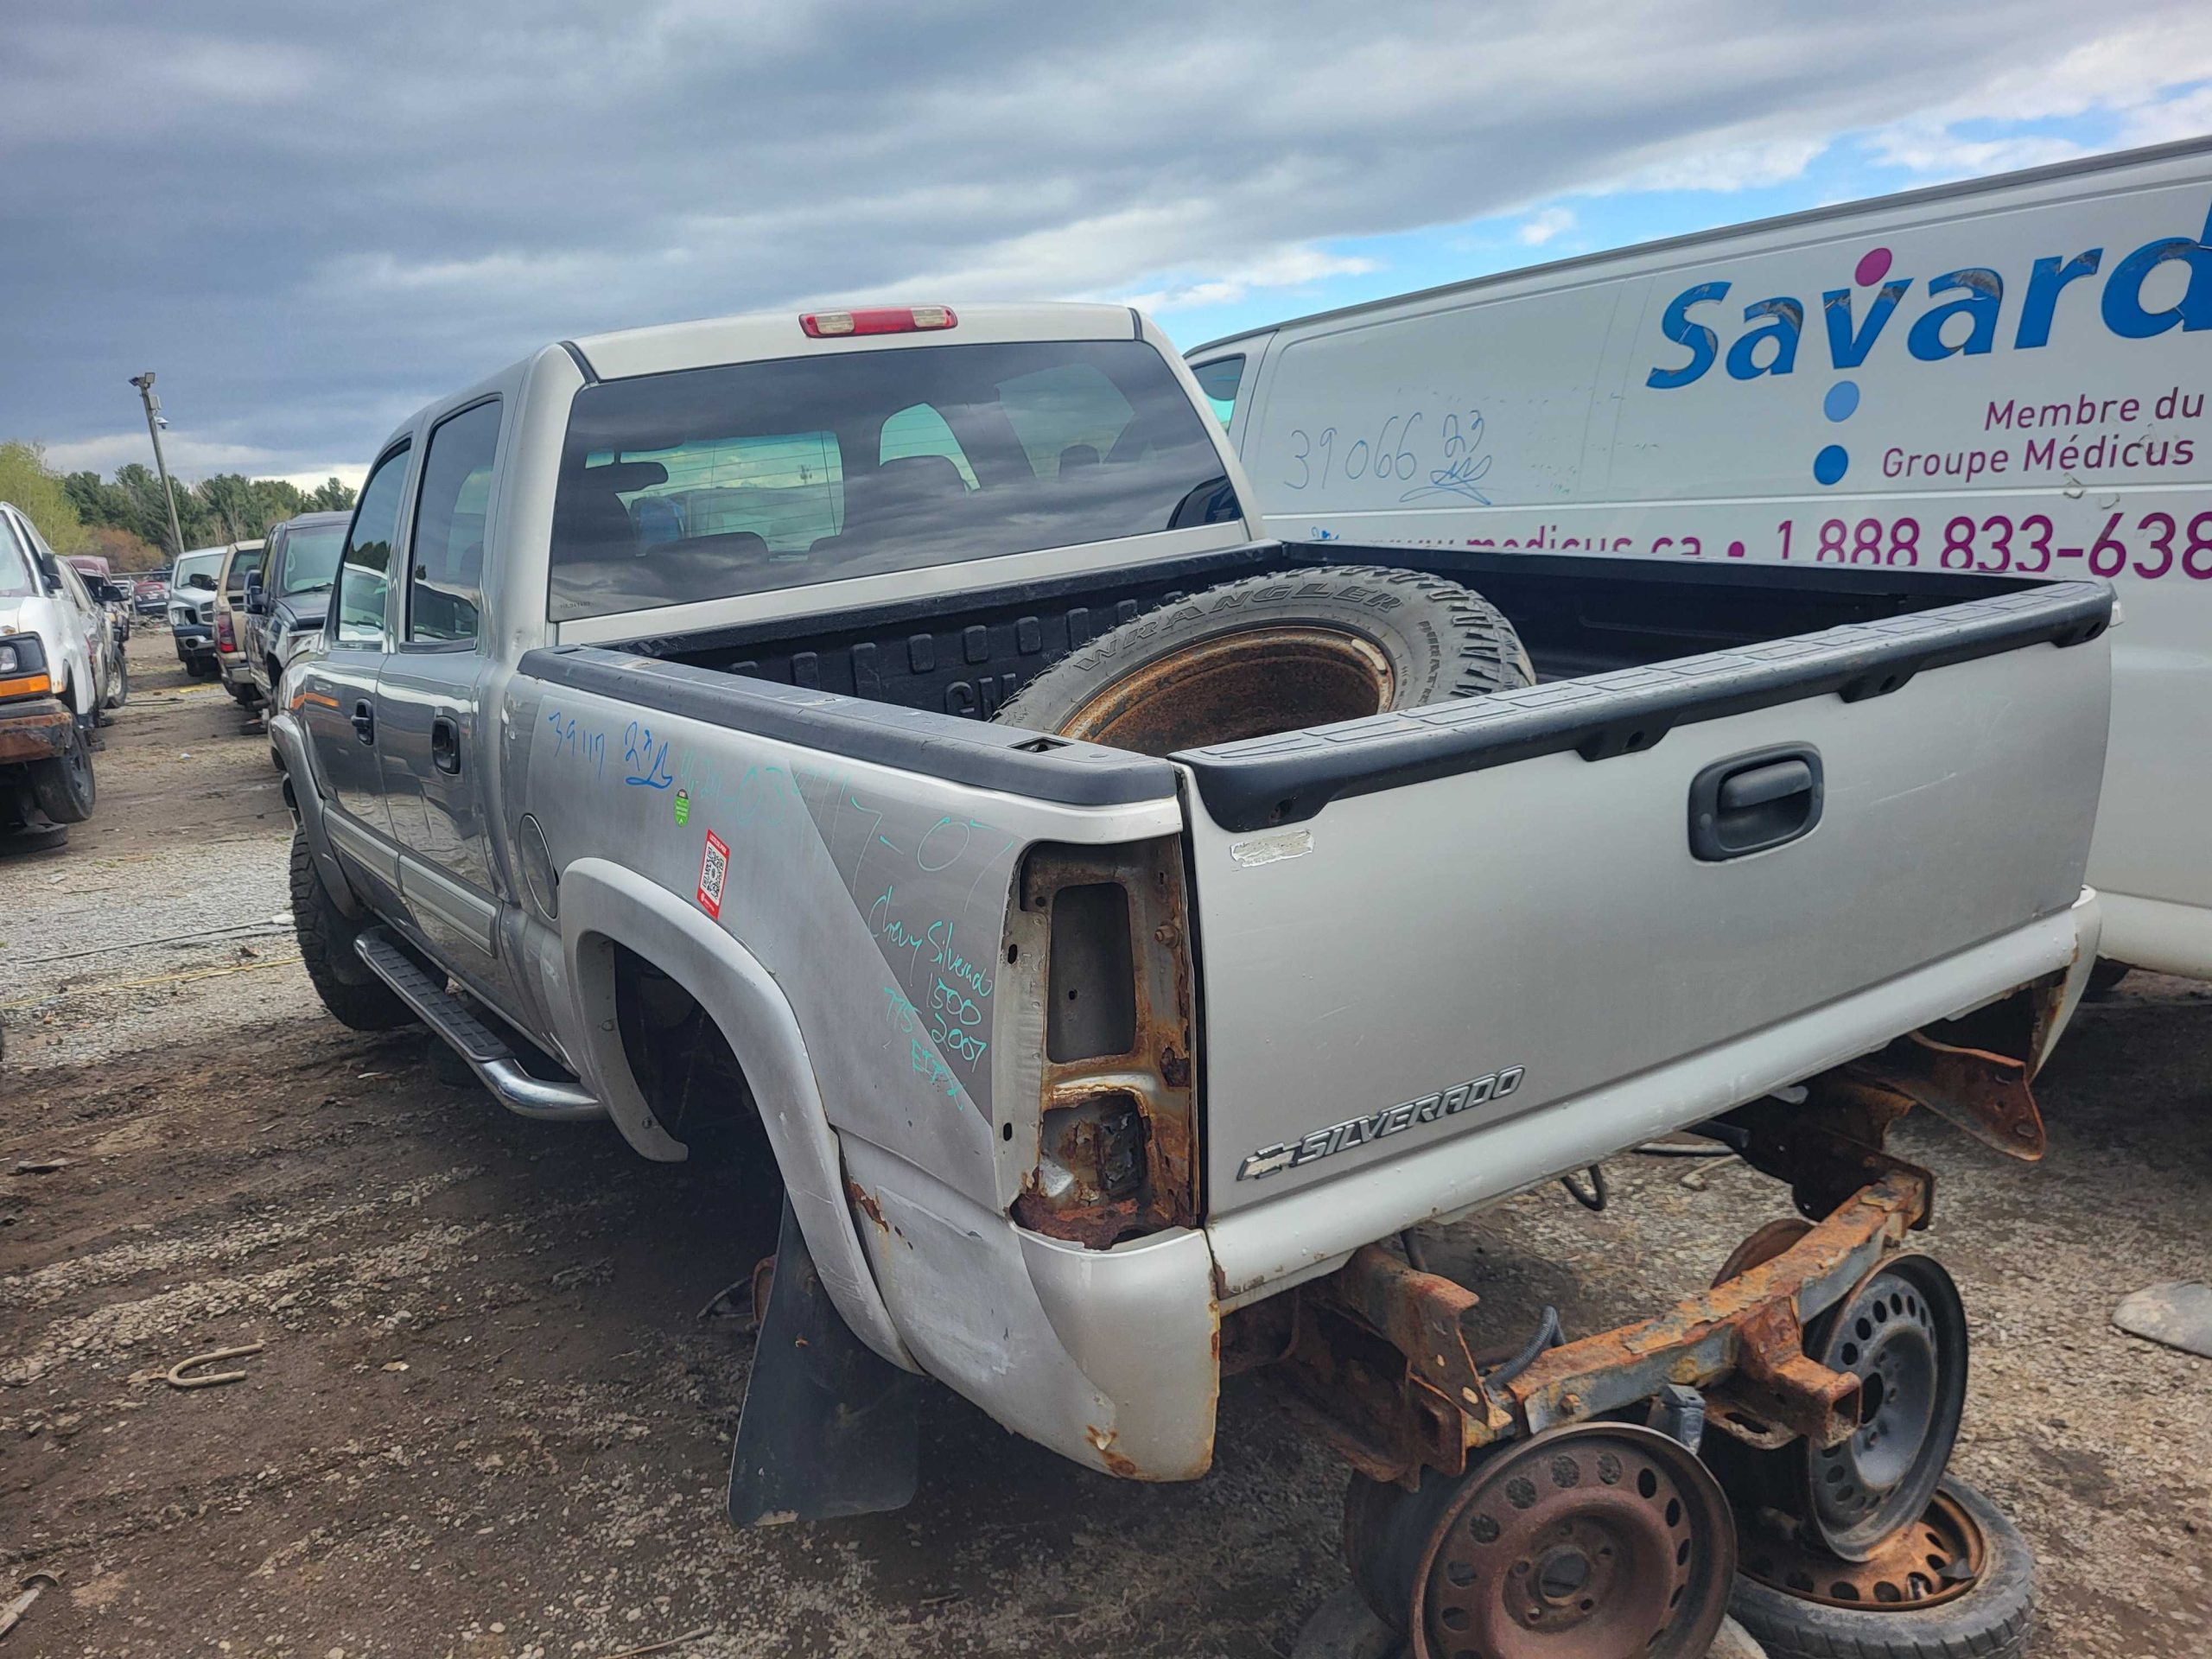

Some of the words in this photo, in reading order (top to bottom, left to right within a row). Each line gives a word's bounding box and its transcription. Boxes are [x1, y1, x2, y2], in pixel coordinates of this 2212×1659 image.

[1645, 197, 2212, 389] Savard
[1985, 393, 2139, 430] Membre
[2155, 386, 2204, 420] du
[1284, 411, 1422, 490] 39066
[1883, 448, 2010, 483] Groupe
[2023, 434, 2195, 472] Médicus
[1816, 518, 1920, 566] 888
[1072, 582, 1402, 671] WRANGLER
[926, 972, 982, 1026] 1500
[931, 1012, 988, 1073] 2007
[1297, 1063, 1525, 1166] SILVERADO
